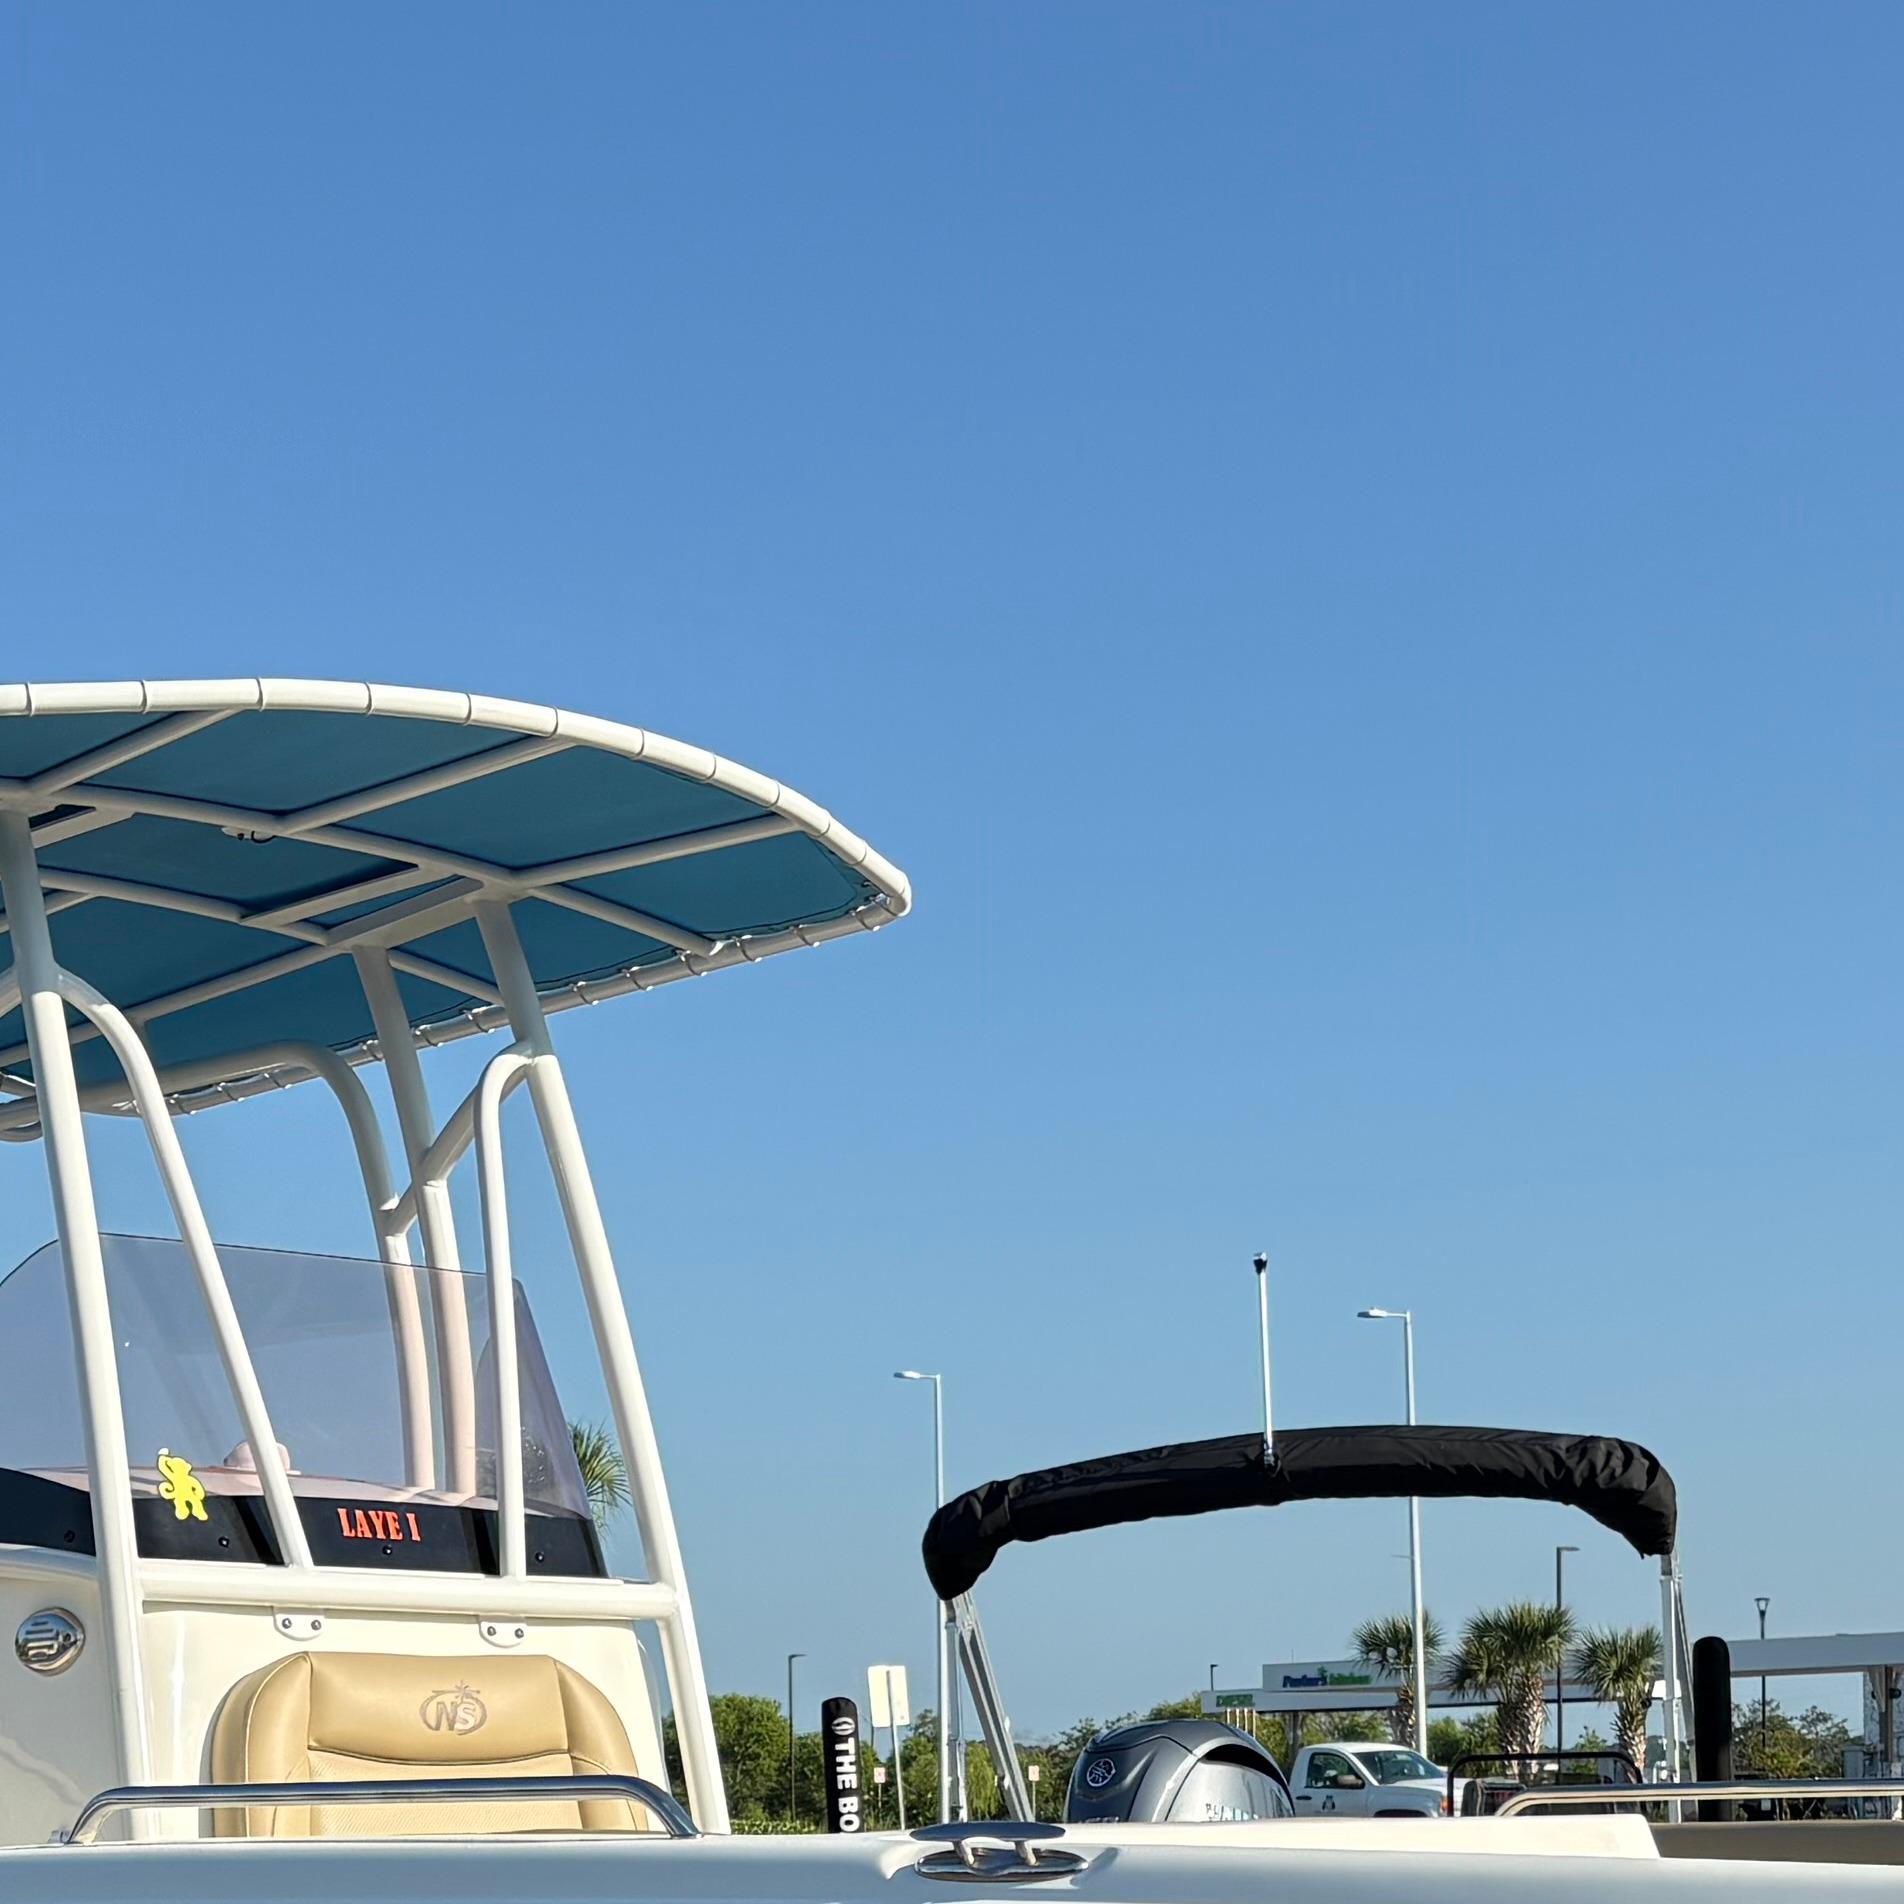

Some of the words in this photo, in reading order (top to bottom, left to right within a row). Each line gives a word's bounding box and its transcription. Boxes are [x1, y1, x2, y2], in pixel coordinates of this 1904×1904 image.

[337, 1508, 403, 1541] LAYE
[835, 1737, 857, 1790] THE
[837, 1796, 860, 1832] BO
